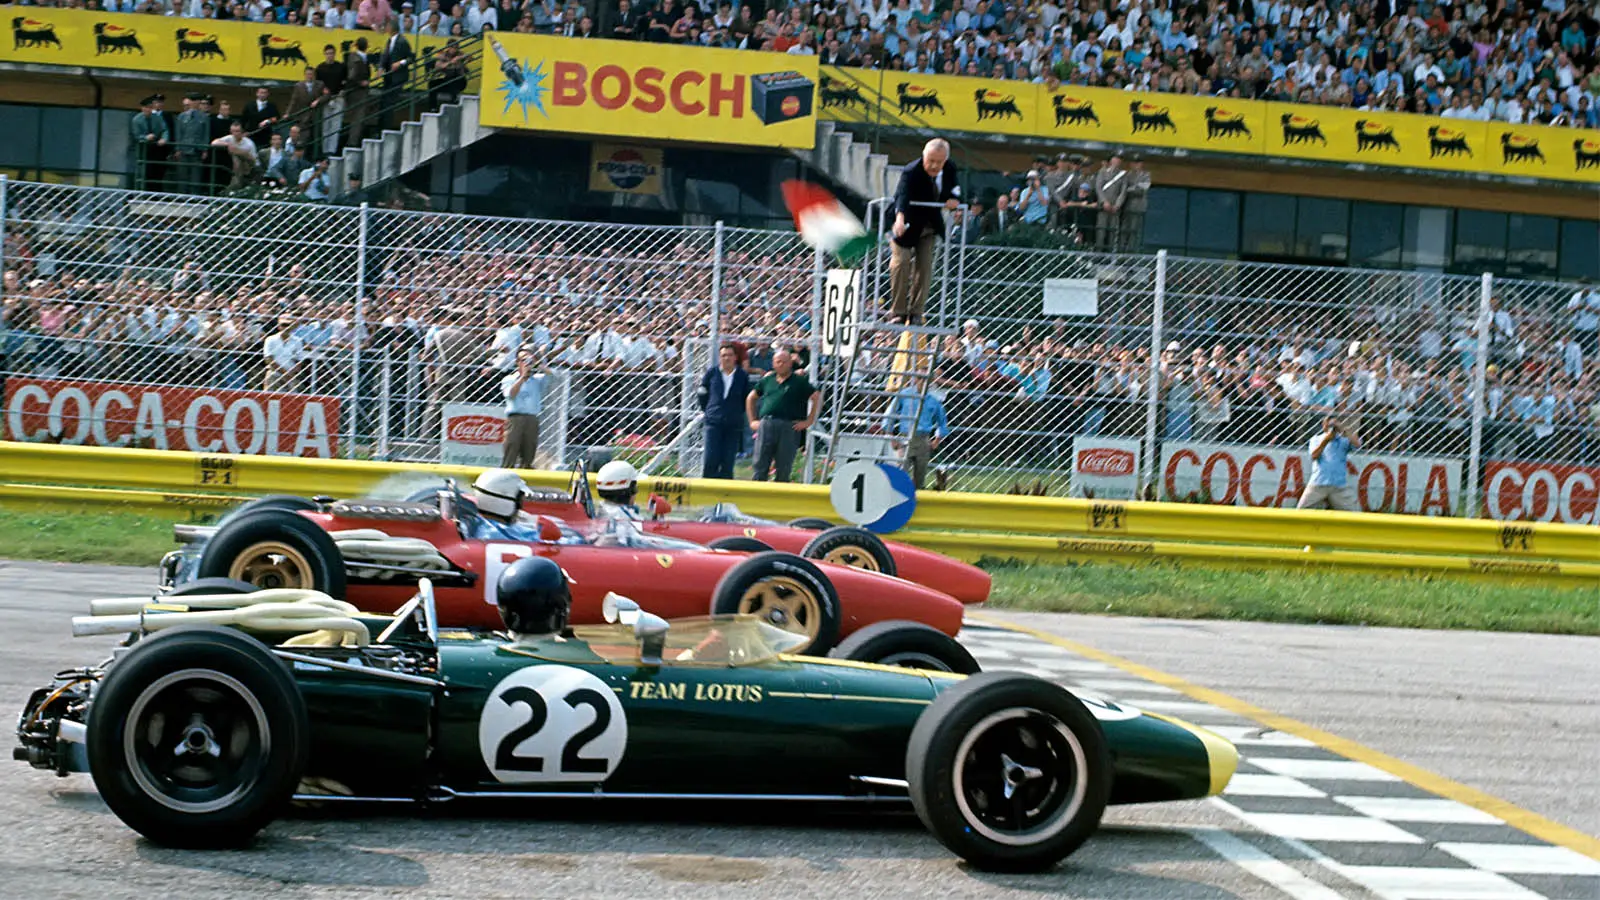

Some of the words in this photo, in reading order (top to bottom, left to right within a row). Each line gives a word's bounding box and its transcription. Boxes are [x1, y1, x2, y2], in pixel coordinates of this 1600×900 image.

[552, 61, 746, 119] BOSCH
[827, 284, 854, 346] 68
[8, 384, 331, 459] COCA-COLA
[852, 473, 865, 512] 1
[1488, 467, 1600, 526] COC
[630, 681, 686, 700] TEAM
[694, 683, 763, 702] LOTUS
[495, 686, 612, 773] 22
